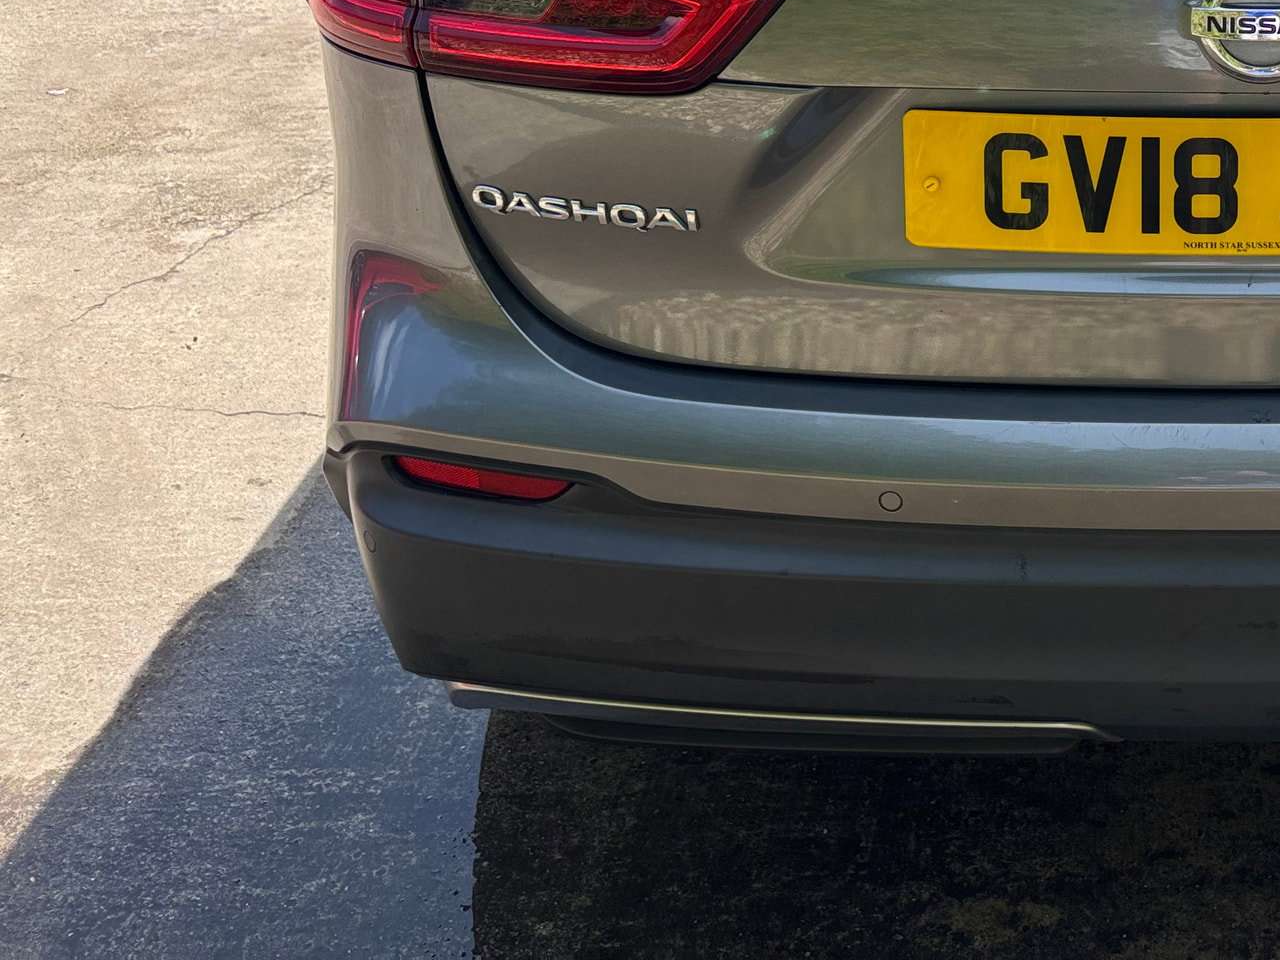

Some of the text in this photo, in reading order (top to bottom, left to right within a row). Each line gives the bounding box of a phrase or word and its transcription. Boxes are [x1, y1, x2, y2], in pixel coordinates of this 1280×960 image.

[472, 184, 700, 232] QASHQAI
[983, 133, 1239, 235] GV18
[1183, 241, 1217, 249] NORTH
[1219, 241, 1244, 249] STAR
[1245, 241, 1280, 249] SUSSEX
